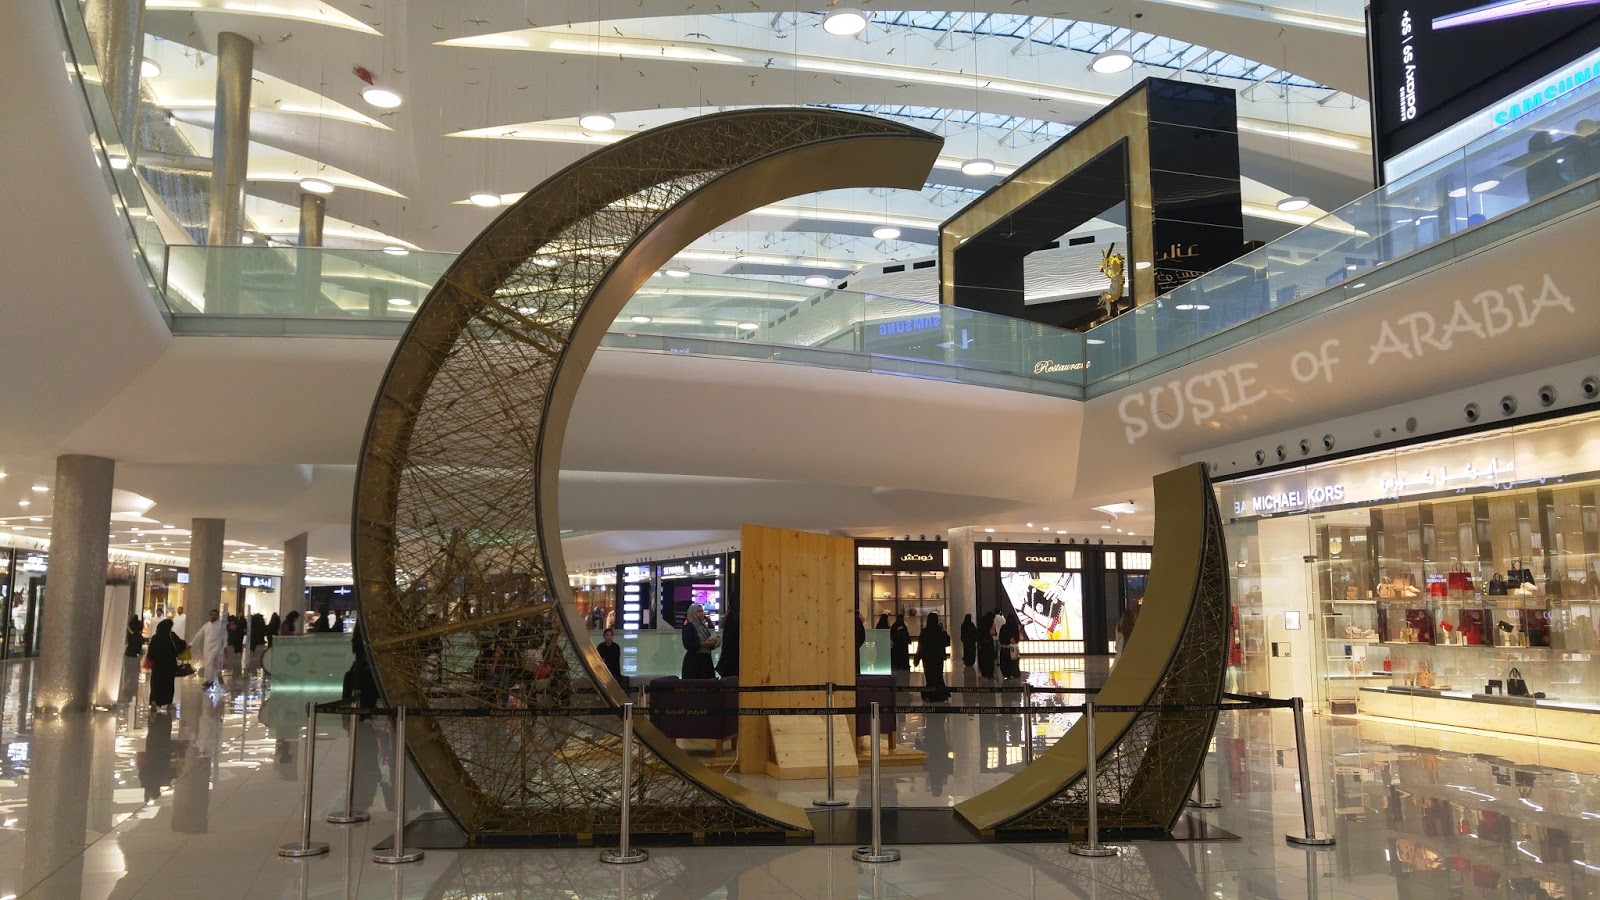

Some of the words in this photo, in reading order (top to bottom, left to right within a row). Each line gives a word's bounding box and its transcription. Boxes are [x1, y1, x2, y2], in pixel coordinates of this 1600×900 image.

[1401, 10, 1412, 36] S9+
[1403, 45, 1413, 64] S9
[1405, 65, 1416, 119] Galaxy
[1252, 490, 1304, 512] MICHAEL
[1307, 483, 1345, 506] KORS
